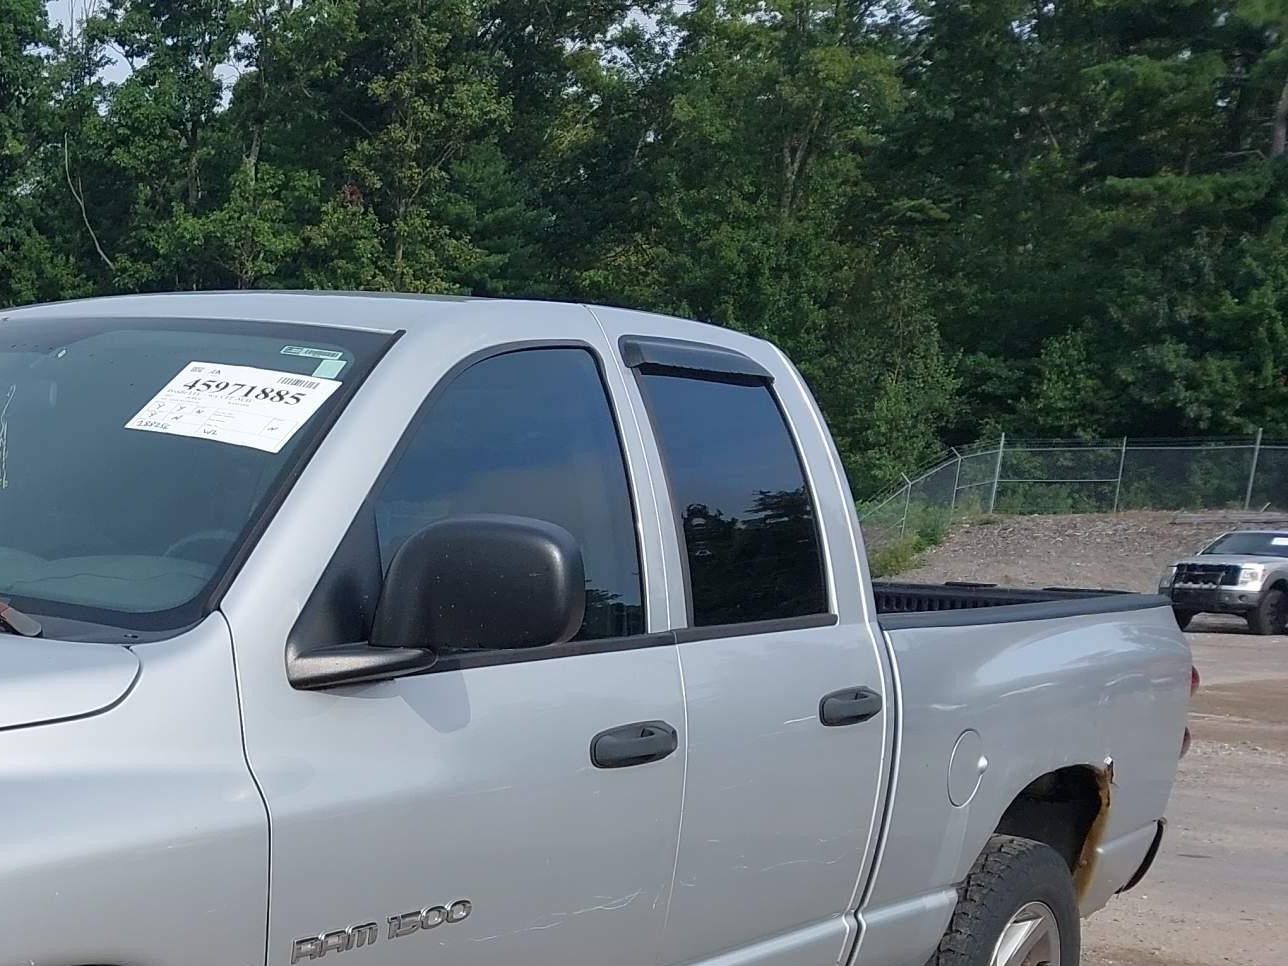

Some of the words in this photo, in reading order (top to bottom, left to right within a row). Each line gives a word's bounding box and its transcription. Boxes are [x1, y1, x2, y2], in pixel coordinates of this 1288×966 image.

[183, 377, 309, 406] 45971885
[290, 921, 379, 965] RAM
[385, 898, 473, 940] 1500
